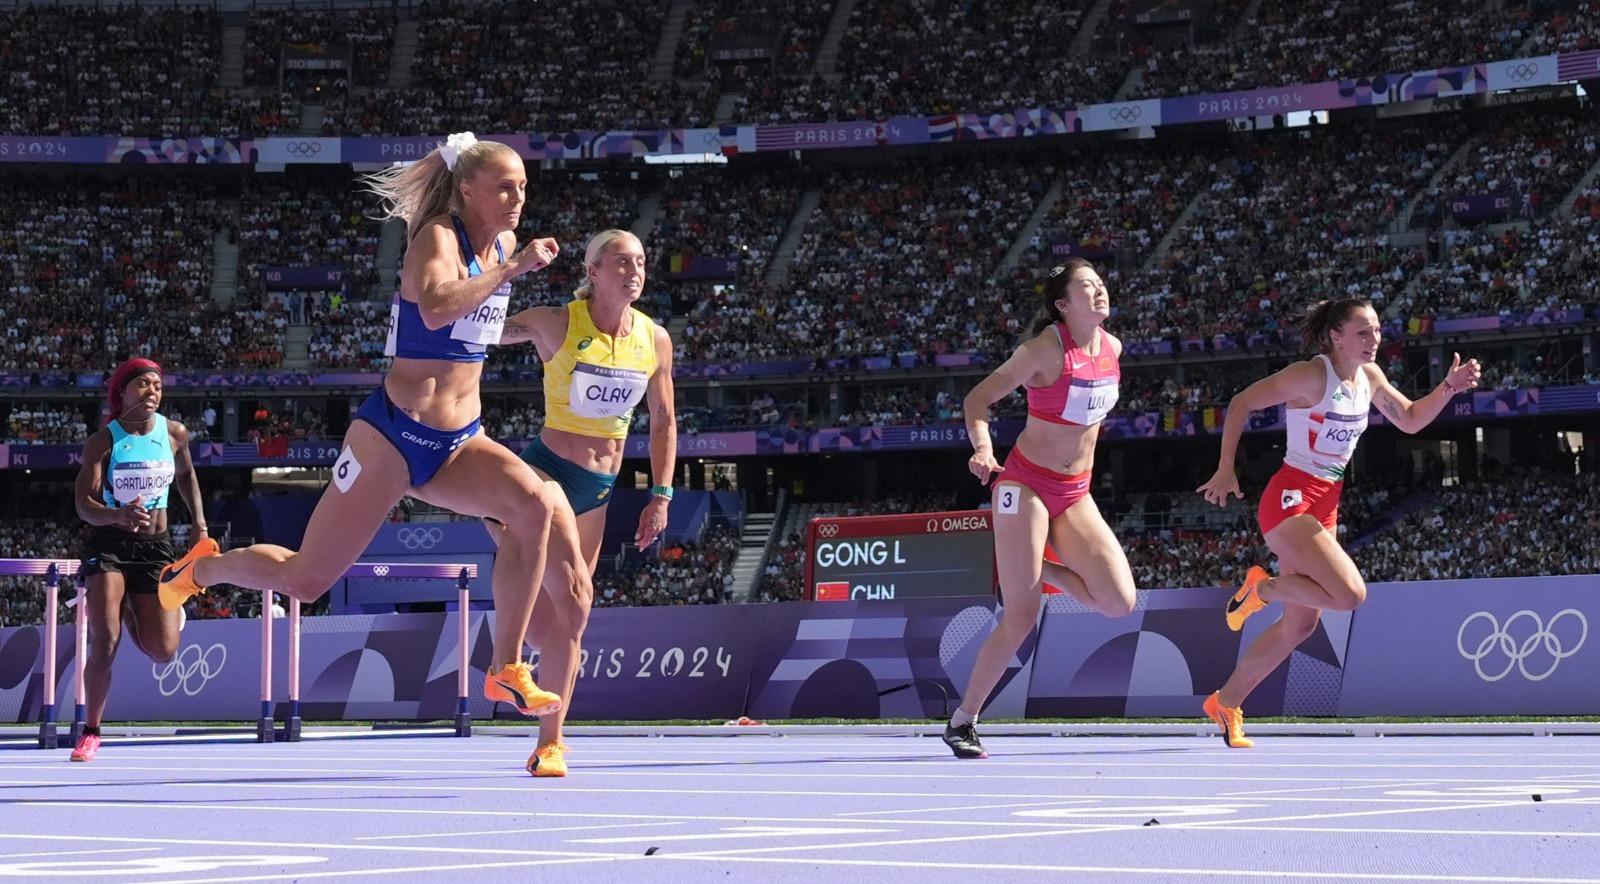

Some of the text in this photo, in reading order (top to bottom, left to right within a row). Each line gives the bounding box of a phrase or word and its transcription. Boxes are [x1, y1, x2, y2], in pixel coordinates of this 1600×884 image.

[586, 384, 634, 404] CLAY
[1454, 402, 1472, 416] H2
[401, 431, 436, 449] CRAFT
[338, 460, 350, 480] 6
[1003, 492, 1014, 509] 3
[942, 516, 988, 532] OMEGA
[816, 540, 907, 568] GONG L
[635, 646, 733, 679] 2024
